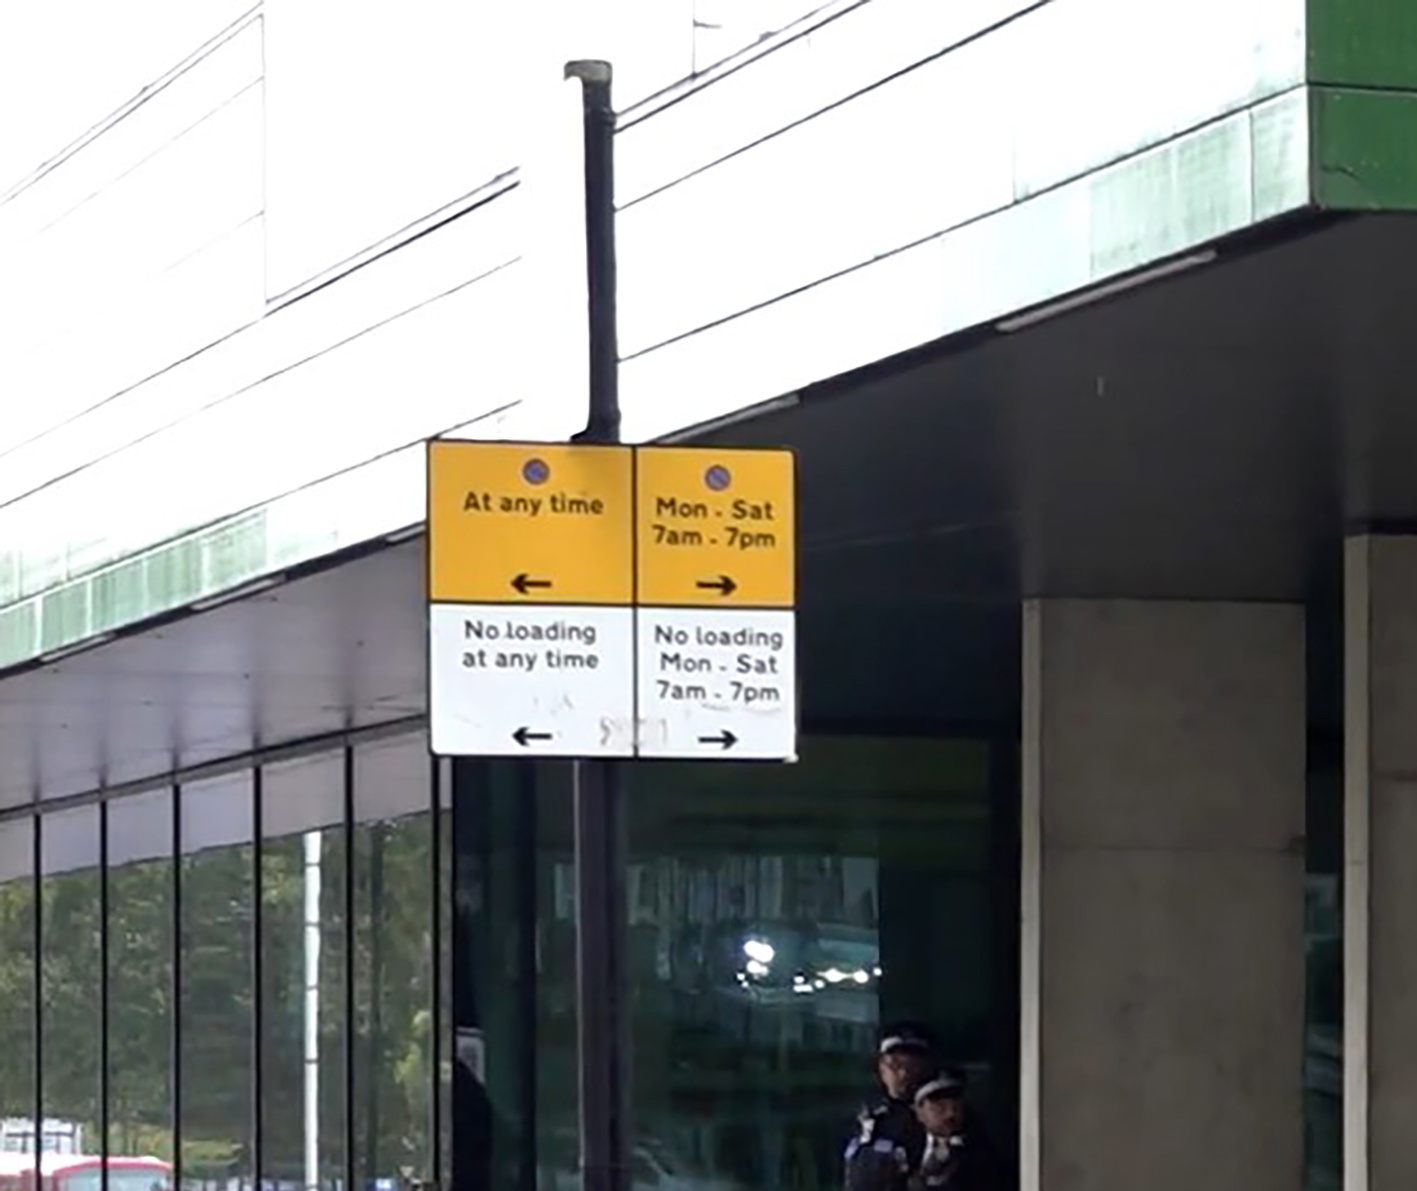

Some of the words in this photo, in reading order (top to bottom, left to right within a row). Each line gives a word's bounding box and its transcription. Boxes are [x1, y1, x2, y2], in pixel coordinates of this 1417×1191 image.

[463, 491, 492, 512] At
[500, 497, 542, 517] any
[551, 493, 604, 516] time
[656, 497, 708, 519] Mon
[732, 499, 774, 521] Sat
[652, 525, 702, 547] 7am
[725, 527, 775, 551] 7pm
[464, 620, 499, 641] No
[505, 621, 597, 646] loading
[655, 625, 689, 646] No
[696, 626, 784, 650] loading
[462, 648, 487, 668] at
[495, 651, 537, 672] any
[546, 649, 599, 669] time
[660, 652, 712, 673] Mon
[737, 653, 779, 674] Sat
[656, 679, 707, 700] 7am
[729, 681, 781, 704] 7pm
